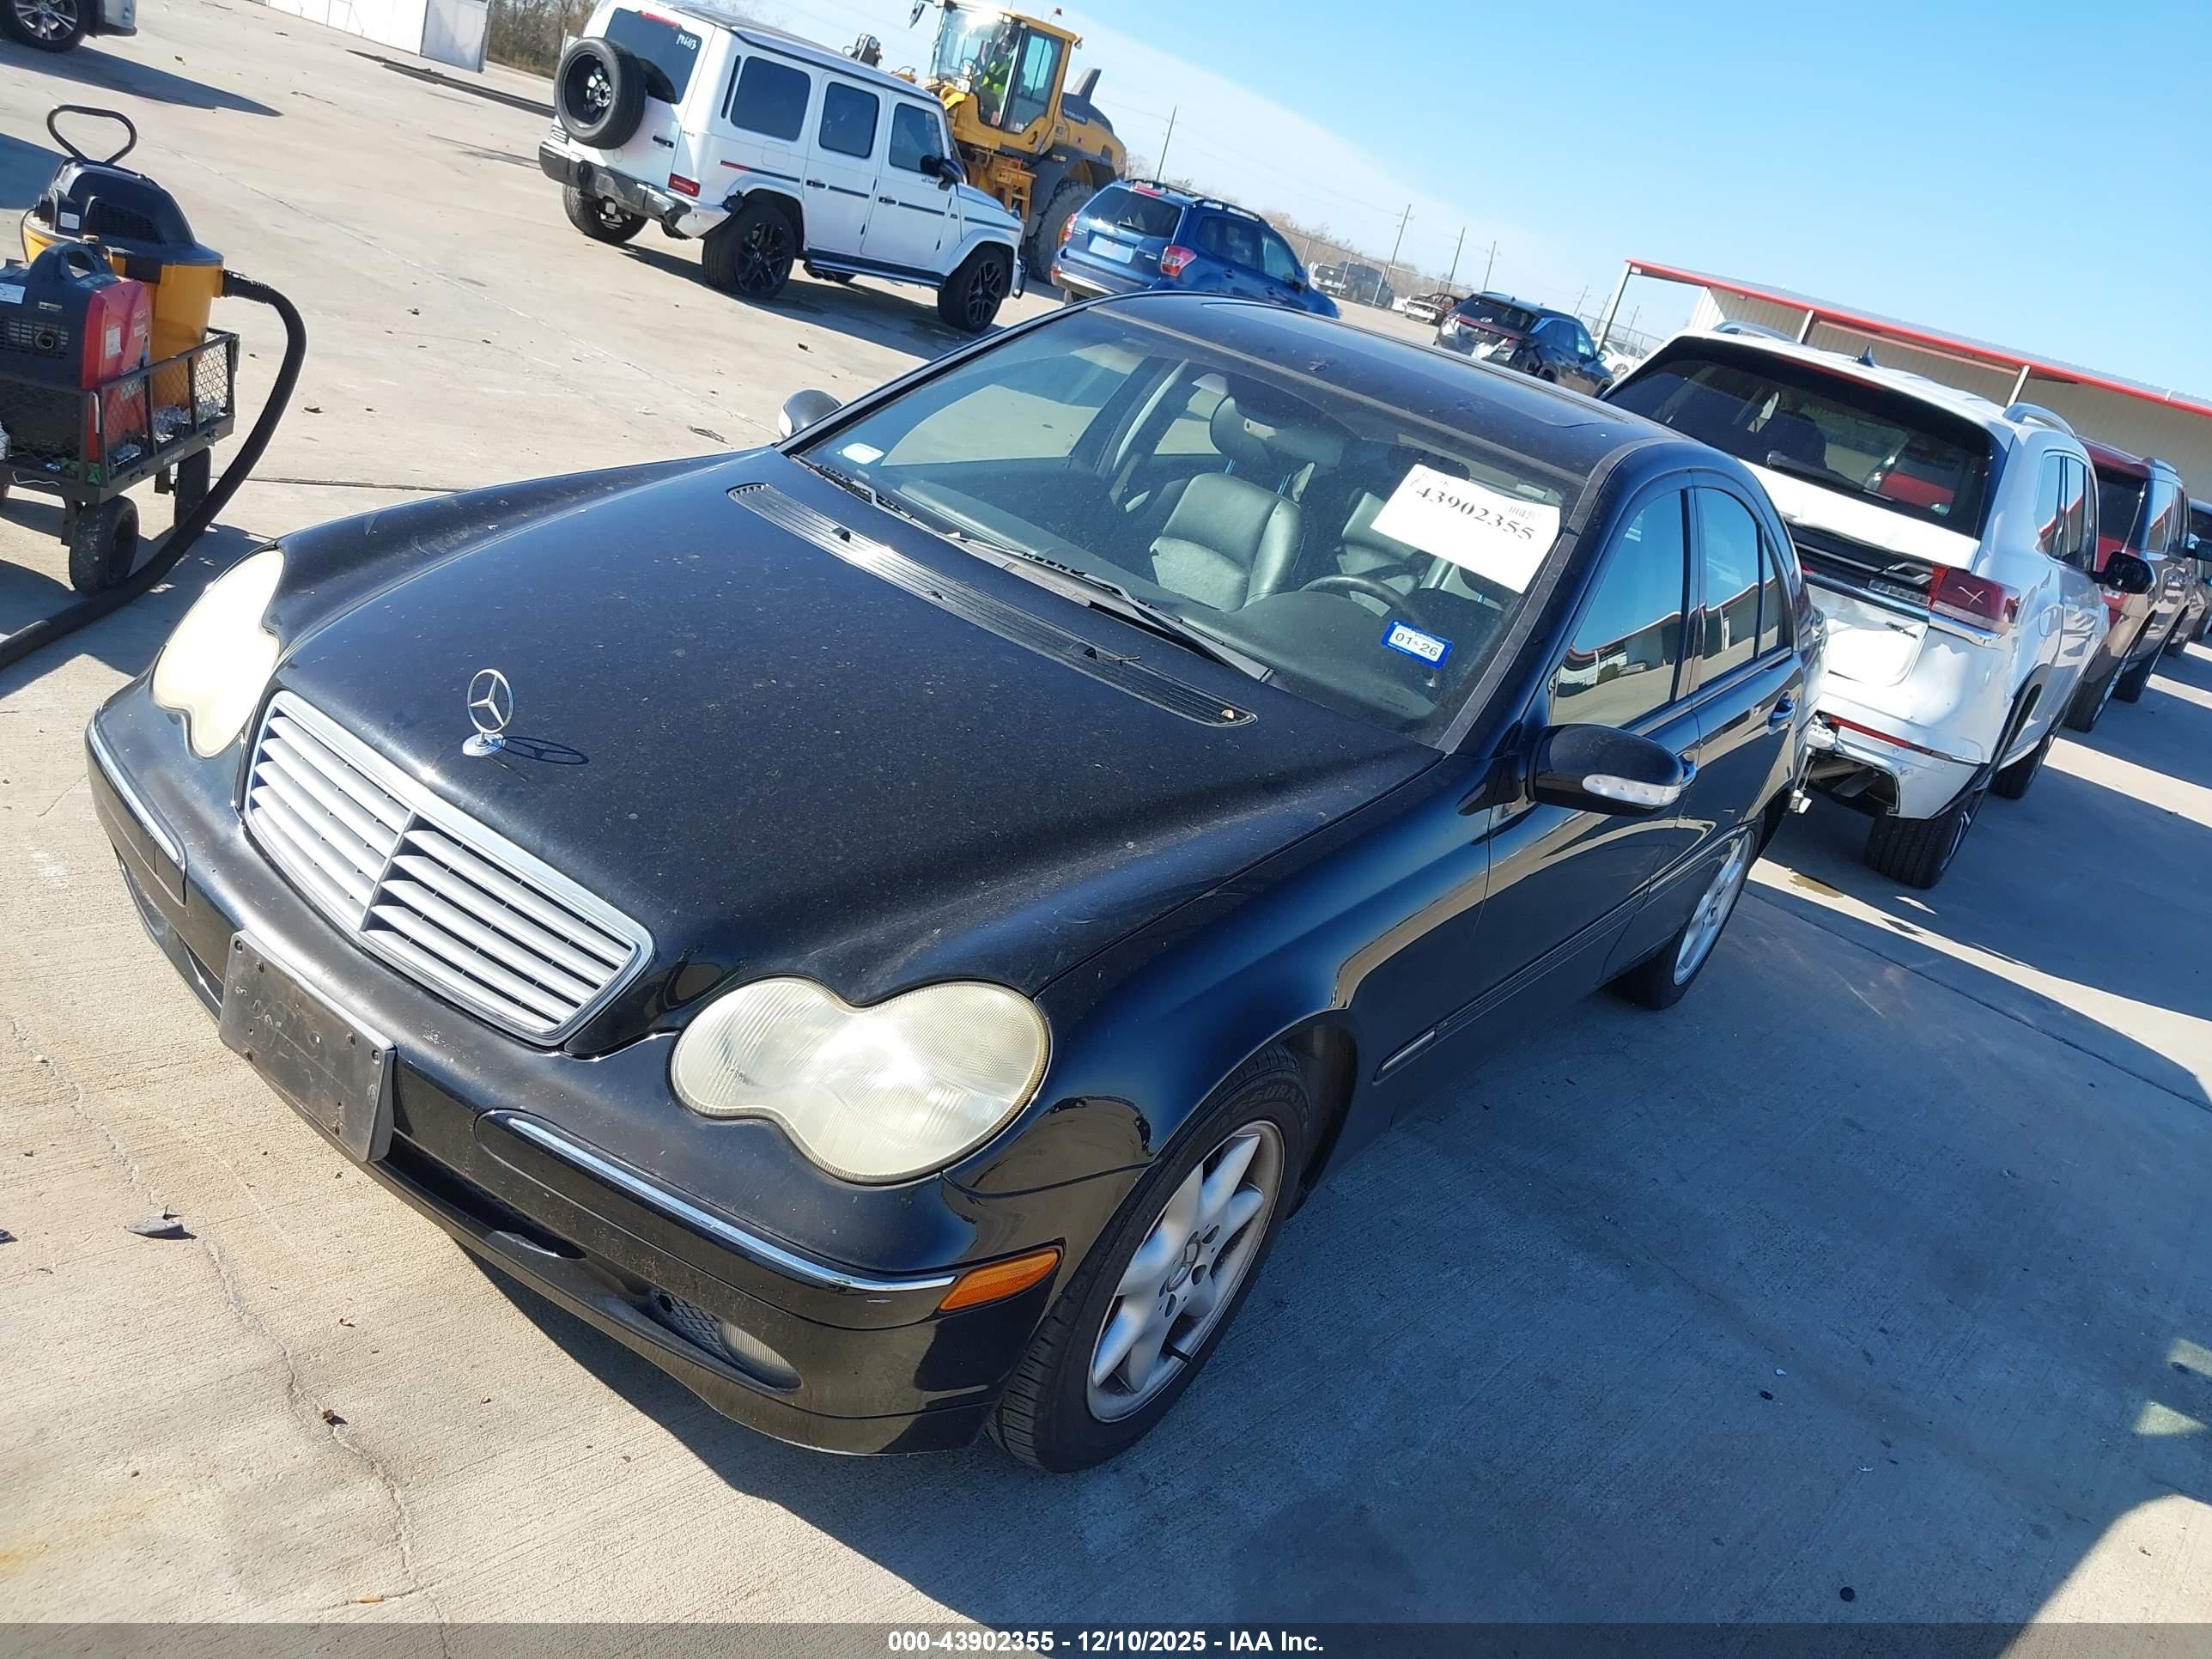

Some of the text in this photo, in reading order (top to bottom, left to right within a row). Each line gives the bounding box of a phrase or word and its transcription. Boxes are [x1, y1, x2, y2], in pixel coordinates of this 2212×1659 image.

[1416, 487, 1535, 540] 43902355
[1395, 632, 1413, 646] 01
[1419, 642, 1439, 657] 26
